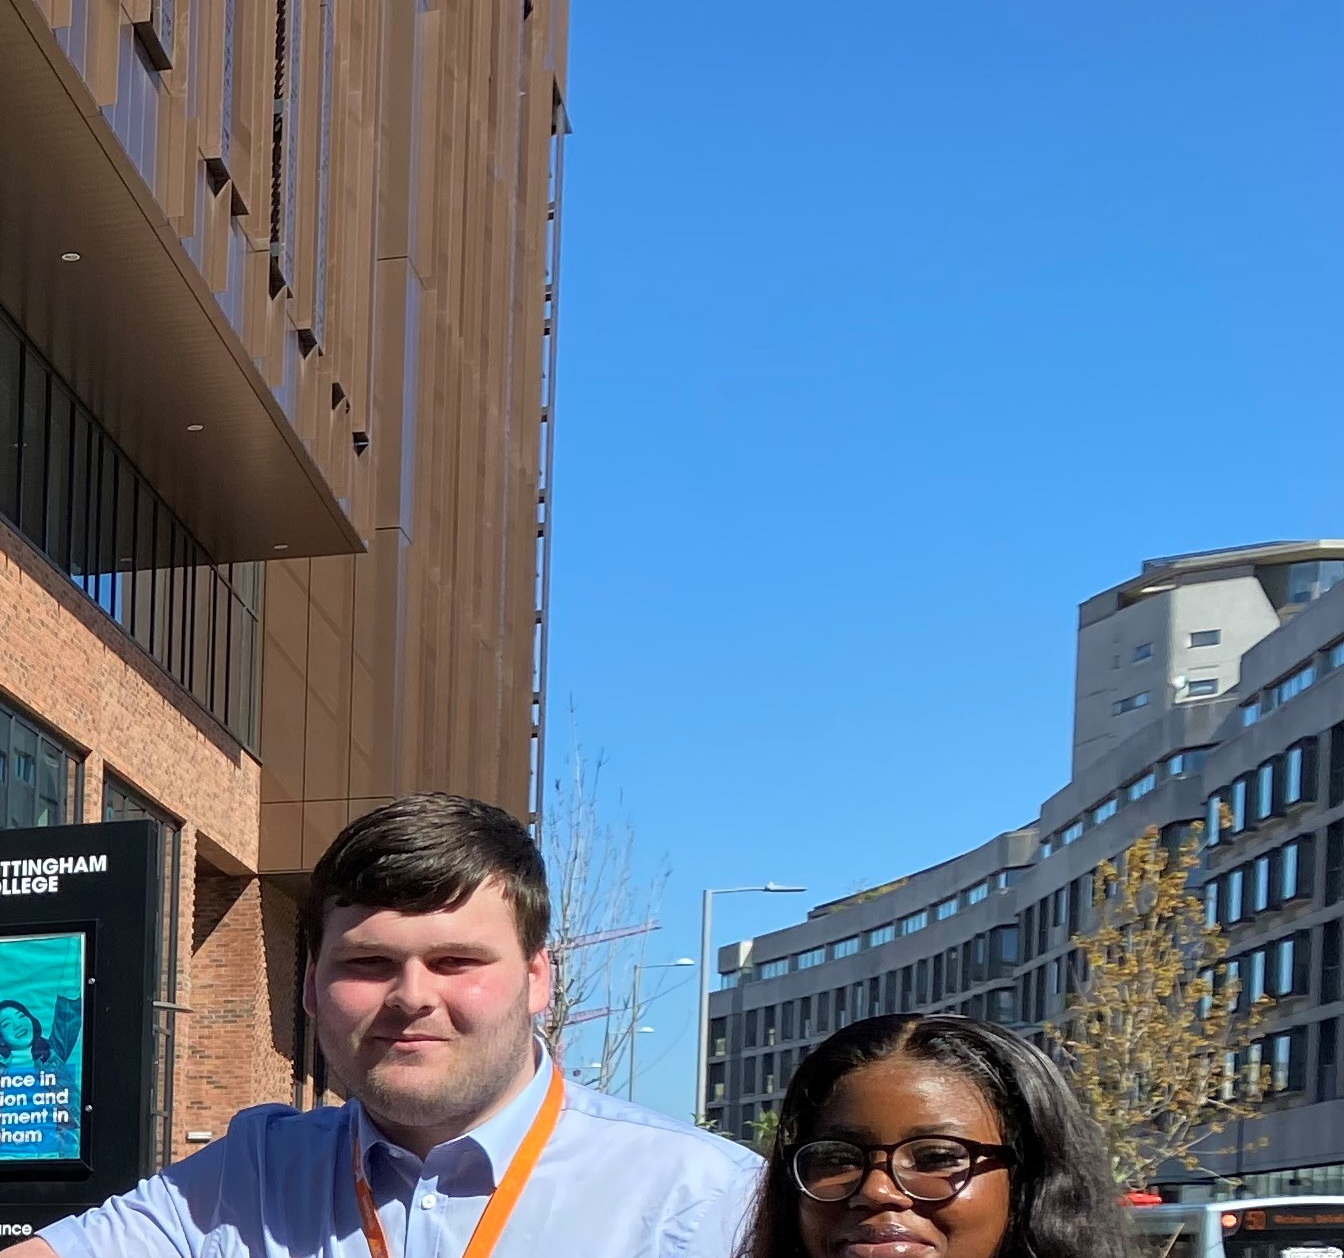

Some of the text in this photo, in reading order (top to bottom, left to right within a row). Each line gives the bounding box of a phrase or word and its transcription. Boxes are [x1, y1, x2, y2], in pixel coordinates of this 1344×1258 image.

[40, 1071, 56, 1086] in
[33, 1089, 69, 1106] and
[53, 1107, 69, 1123] in
